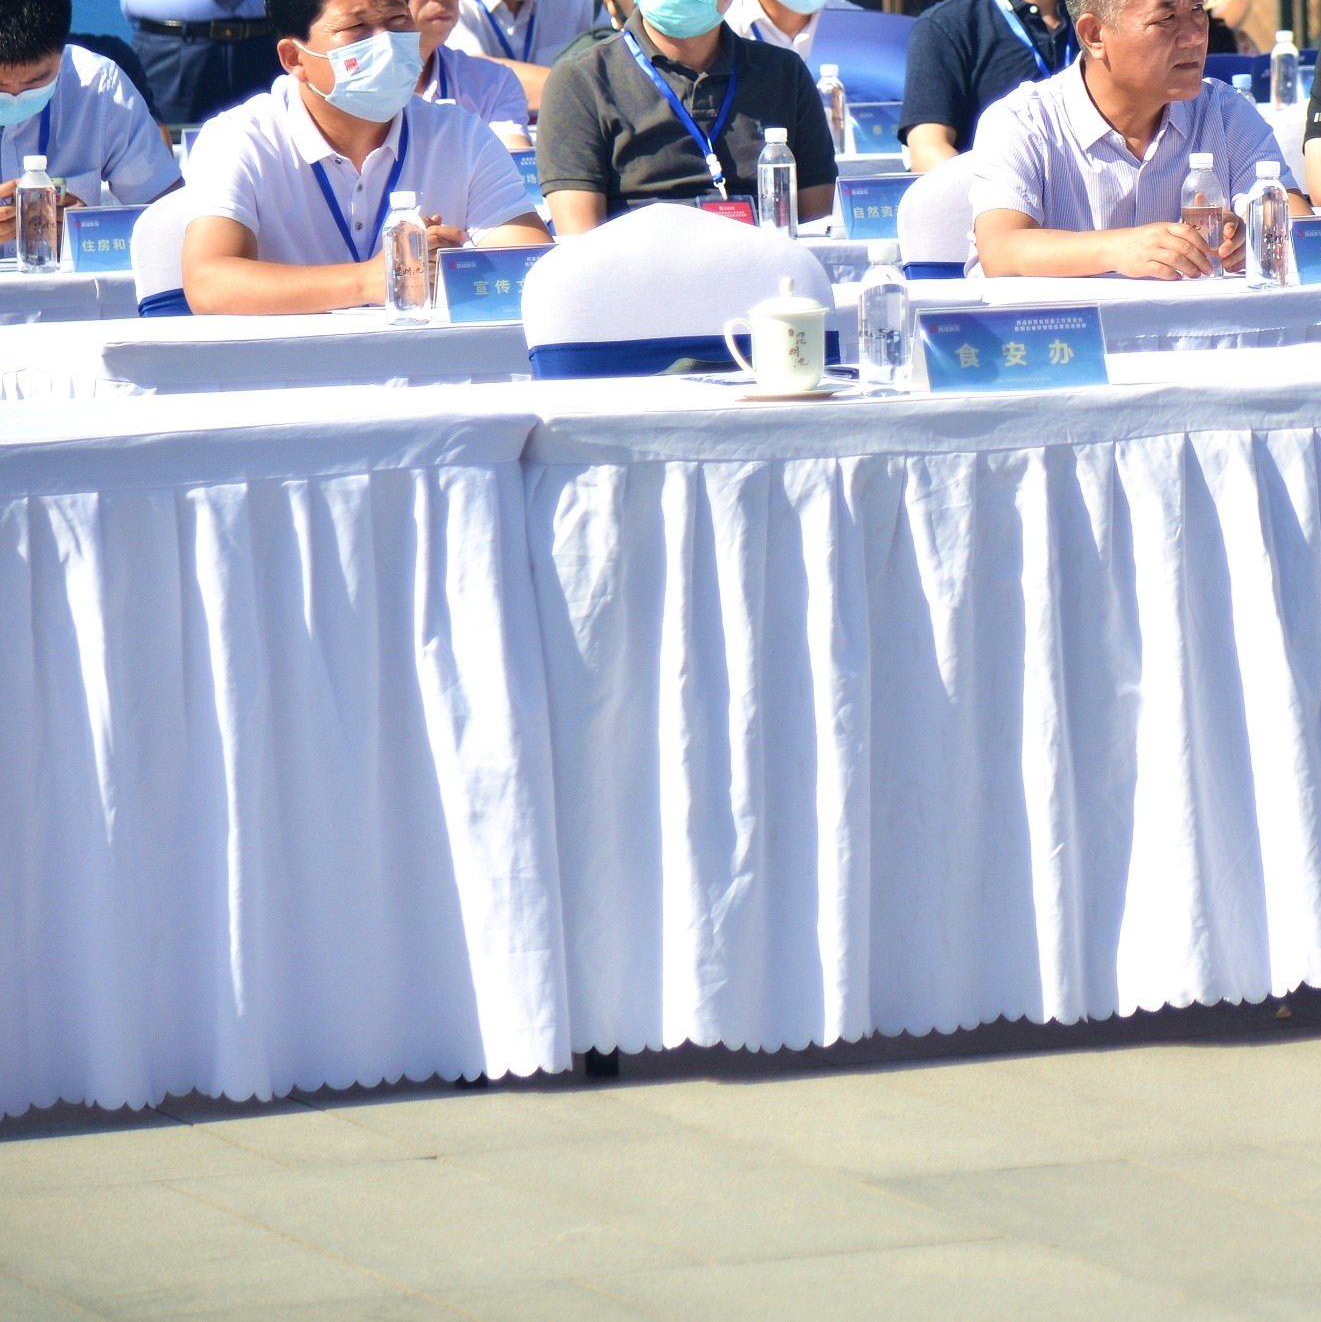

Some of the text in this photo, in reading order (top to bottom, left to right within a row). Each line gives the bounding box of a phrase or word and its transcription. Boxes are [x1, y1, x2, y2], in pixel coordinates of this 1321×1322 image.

[853, 205, 899, 219] 自然资
[82, 238, 131, 253] 住房和
[955, 339, 1075, 368] 食安办
